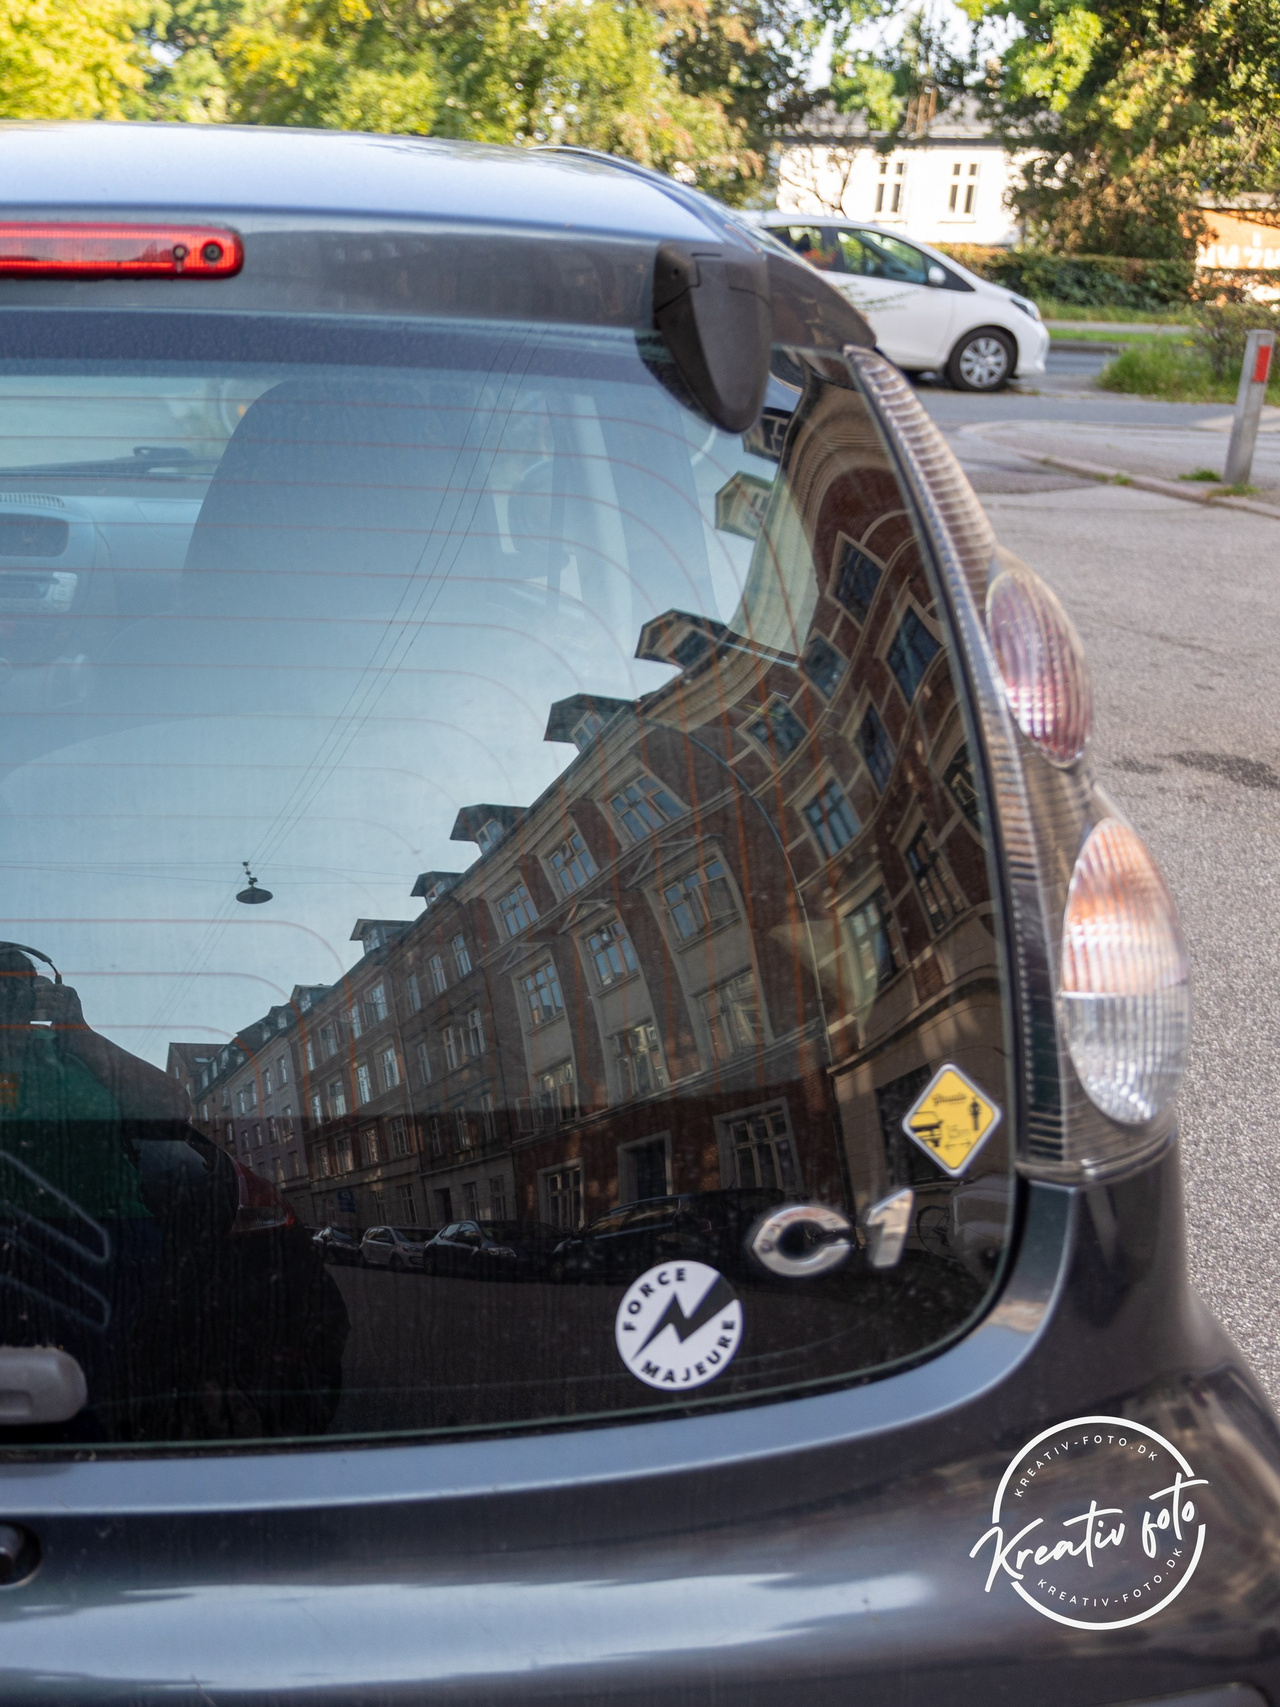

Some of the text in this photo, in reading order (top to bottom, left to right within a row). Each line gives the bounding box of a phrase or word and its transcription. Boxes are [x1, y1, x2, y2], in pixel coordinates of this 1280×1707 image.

[752, 1188, 914, 1277] C1
[623, 1268, 687, 1332] FORCE
[642, 1318, 736, 1382] MAJEURE
